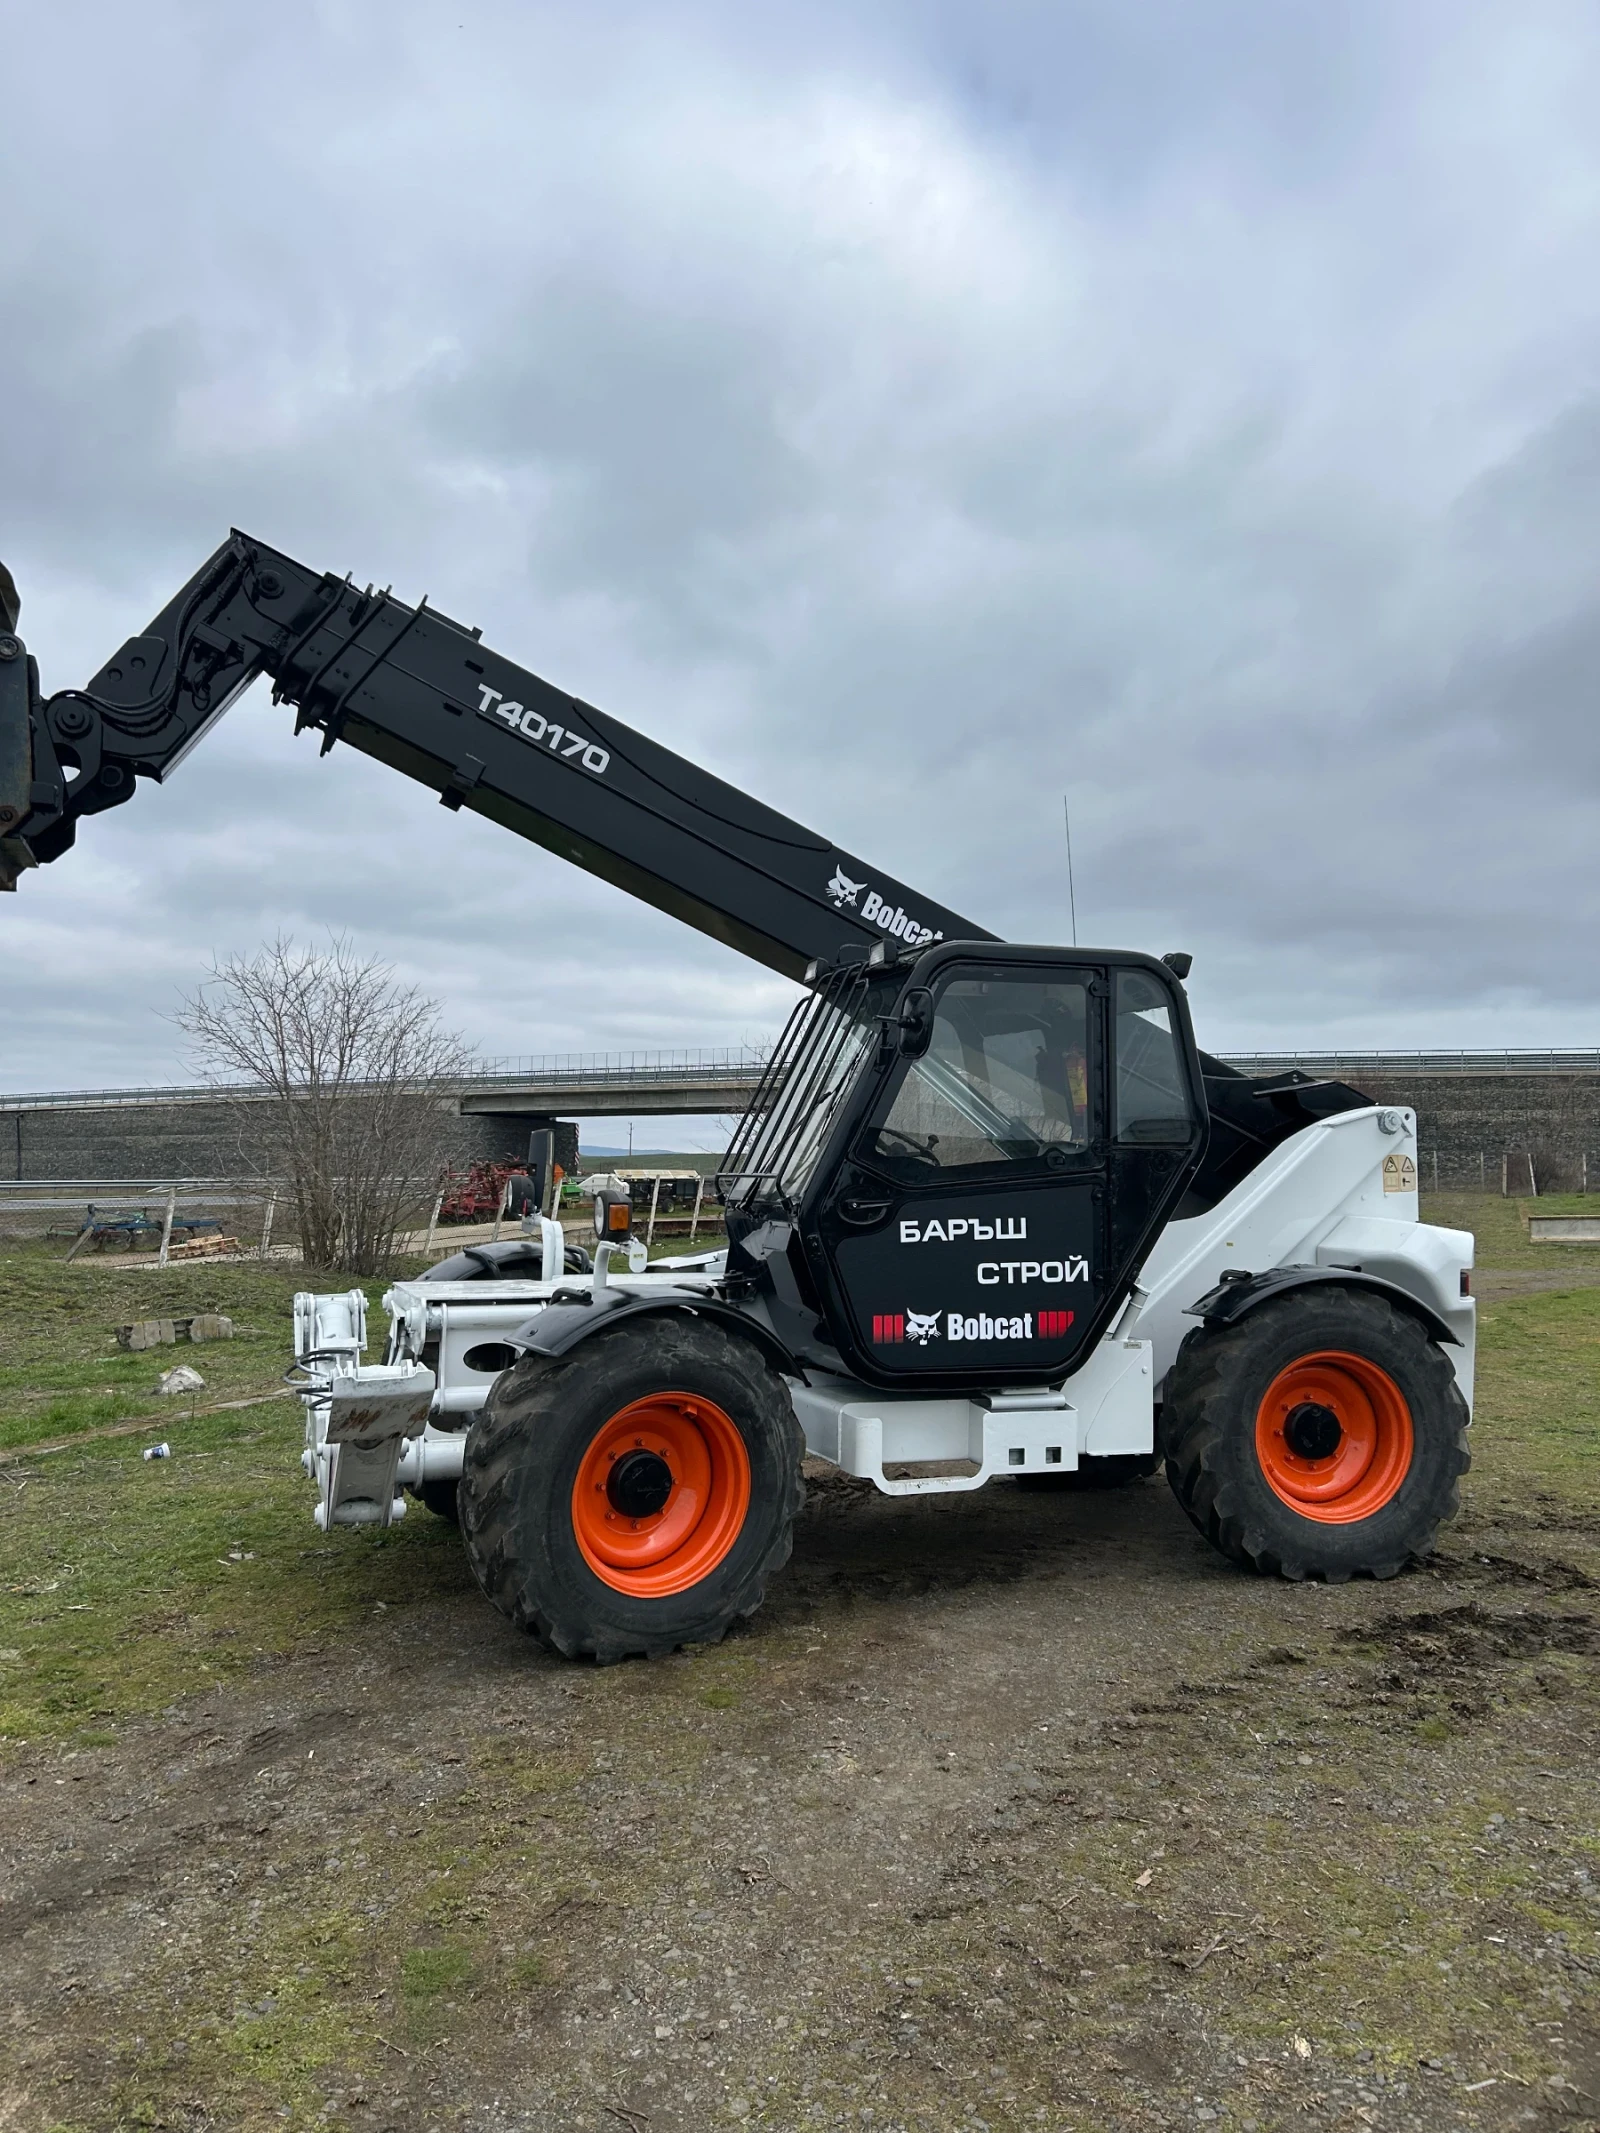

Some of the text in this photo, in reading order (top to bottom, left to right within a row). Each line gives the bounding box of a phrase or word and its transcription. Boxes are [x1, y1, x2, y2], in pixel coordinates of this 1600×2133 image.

[478, 683, 610, 774] T40170
[900, 1217, 1027, 1243] БАРЪШ
[977, 1255, 1089, 1284] СТРОЙ
[947, 1312, 1033, 1341] Bobcat
